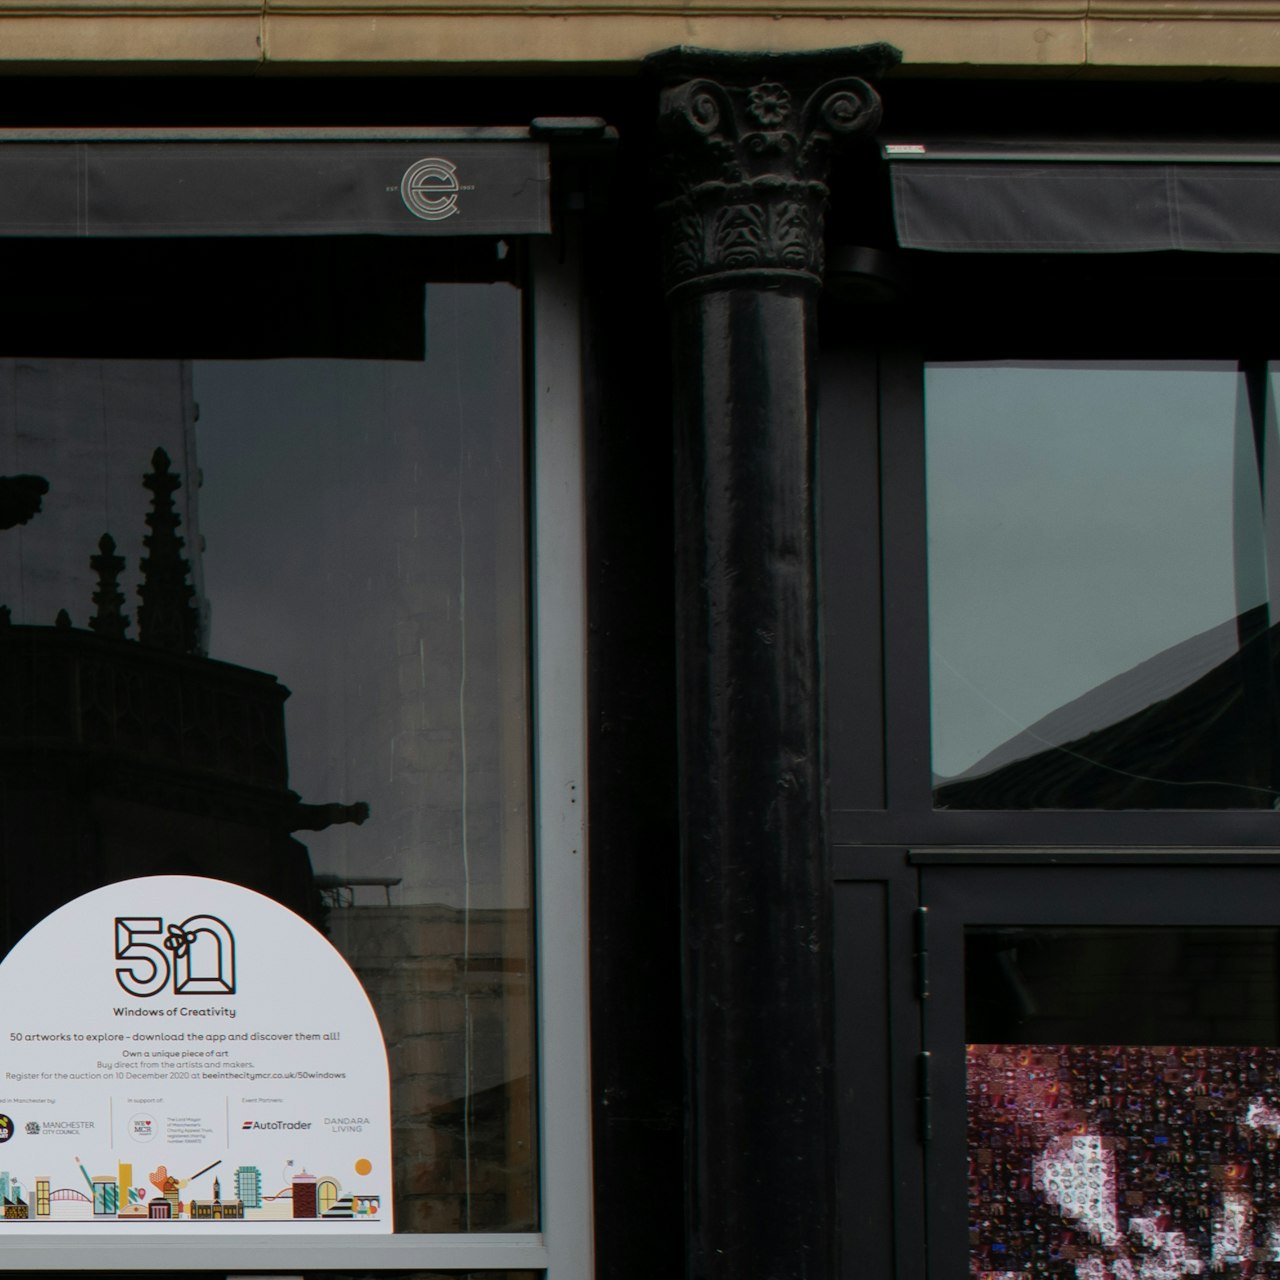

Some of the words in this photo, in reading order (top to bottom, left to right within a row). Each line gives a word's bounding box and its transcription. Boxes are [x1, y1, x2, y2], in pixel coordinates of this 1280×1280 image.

[112, 1007, 164, 1017] Windows
[166, 1007, 178, 1017] of
[179, 1007, 237, 1018] Creativity
[10, 1032, 22, 1041] 50
[24, 1032, 71, 1041] artworks
[73, 1032, 84, 1041] to
[86, 1032, 125, 1043] explore
[132, 1032, 185, 1041] download
[187, 1032, 203, 1041] the
[205, 1032, 226, 1042] app
[228, 1032, 248, 1041] and
[250, 1032, 292, 1041] discover
[294, 1032, 321, 1041] them
[322, 1032, 341, 1041] all!
[122, 1050, 142, 1058] Own
[144, 1050, 150, 1058] a
[152, 1050, 180, 1059] unique
[181, 1050, 204, 1059] piece
[205, 1050, 214, 1058] of
[215, 1050, 229, 1058] art
[97, 1061, 112, 1070] Buy
[5, 1072, 39, 1081] Register
[41, 1072, 52, 1080] for
[54, 1072, 68, 1080] the
[69, 1072, 102, 1080] auction
[103, 1072, 114, 1080] on
[115, 1072, 124, 1080] 10
[125, 1072, 168, 1080] December
[169, 1072, 190, 1080] 2020
[191, 1072, 200, 1080] at
[202, 1072, 347, 1081] beeinthecitymcr.co.uk/50windows
[42, 1121, 95, 1129] MANCHESTER
[253, 1120, 312, 1130] AutoTrader
[324, 1117, 370, 1125] DANDARA
[332, 1125, 363, 1133] LIVING
